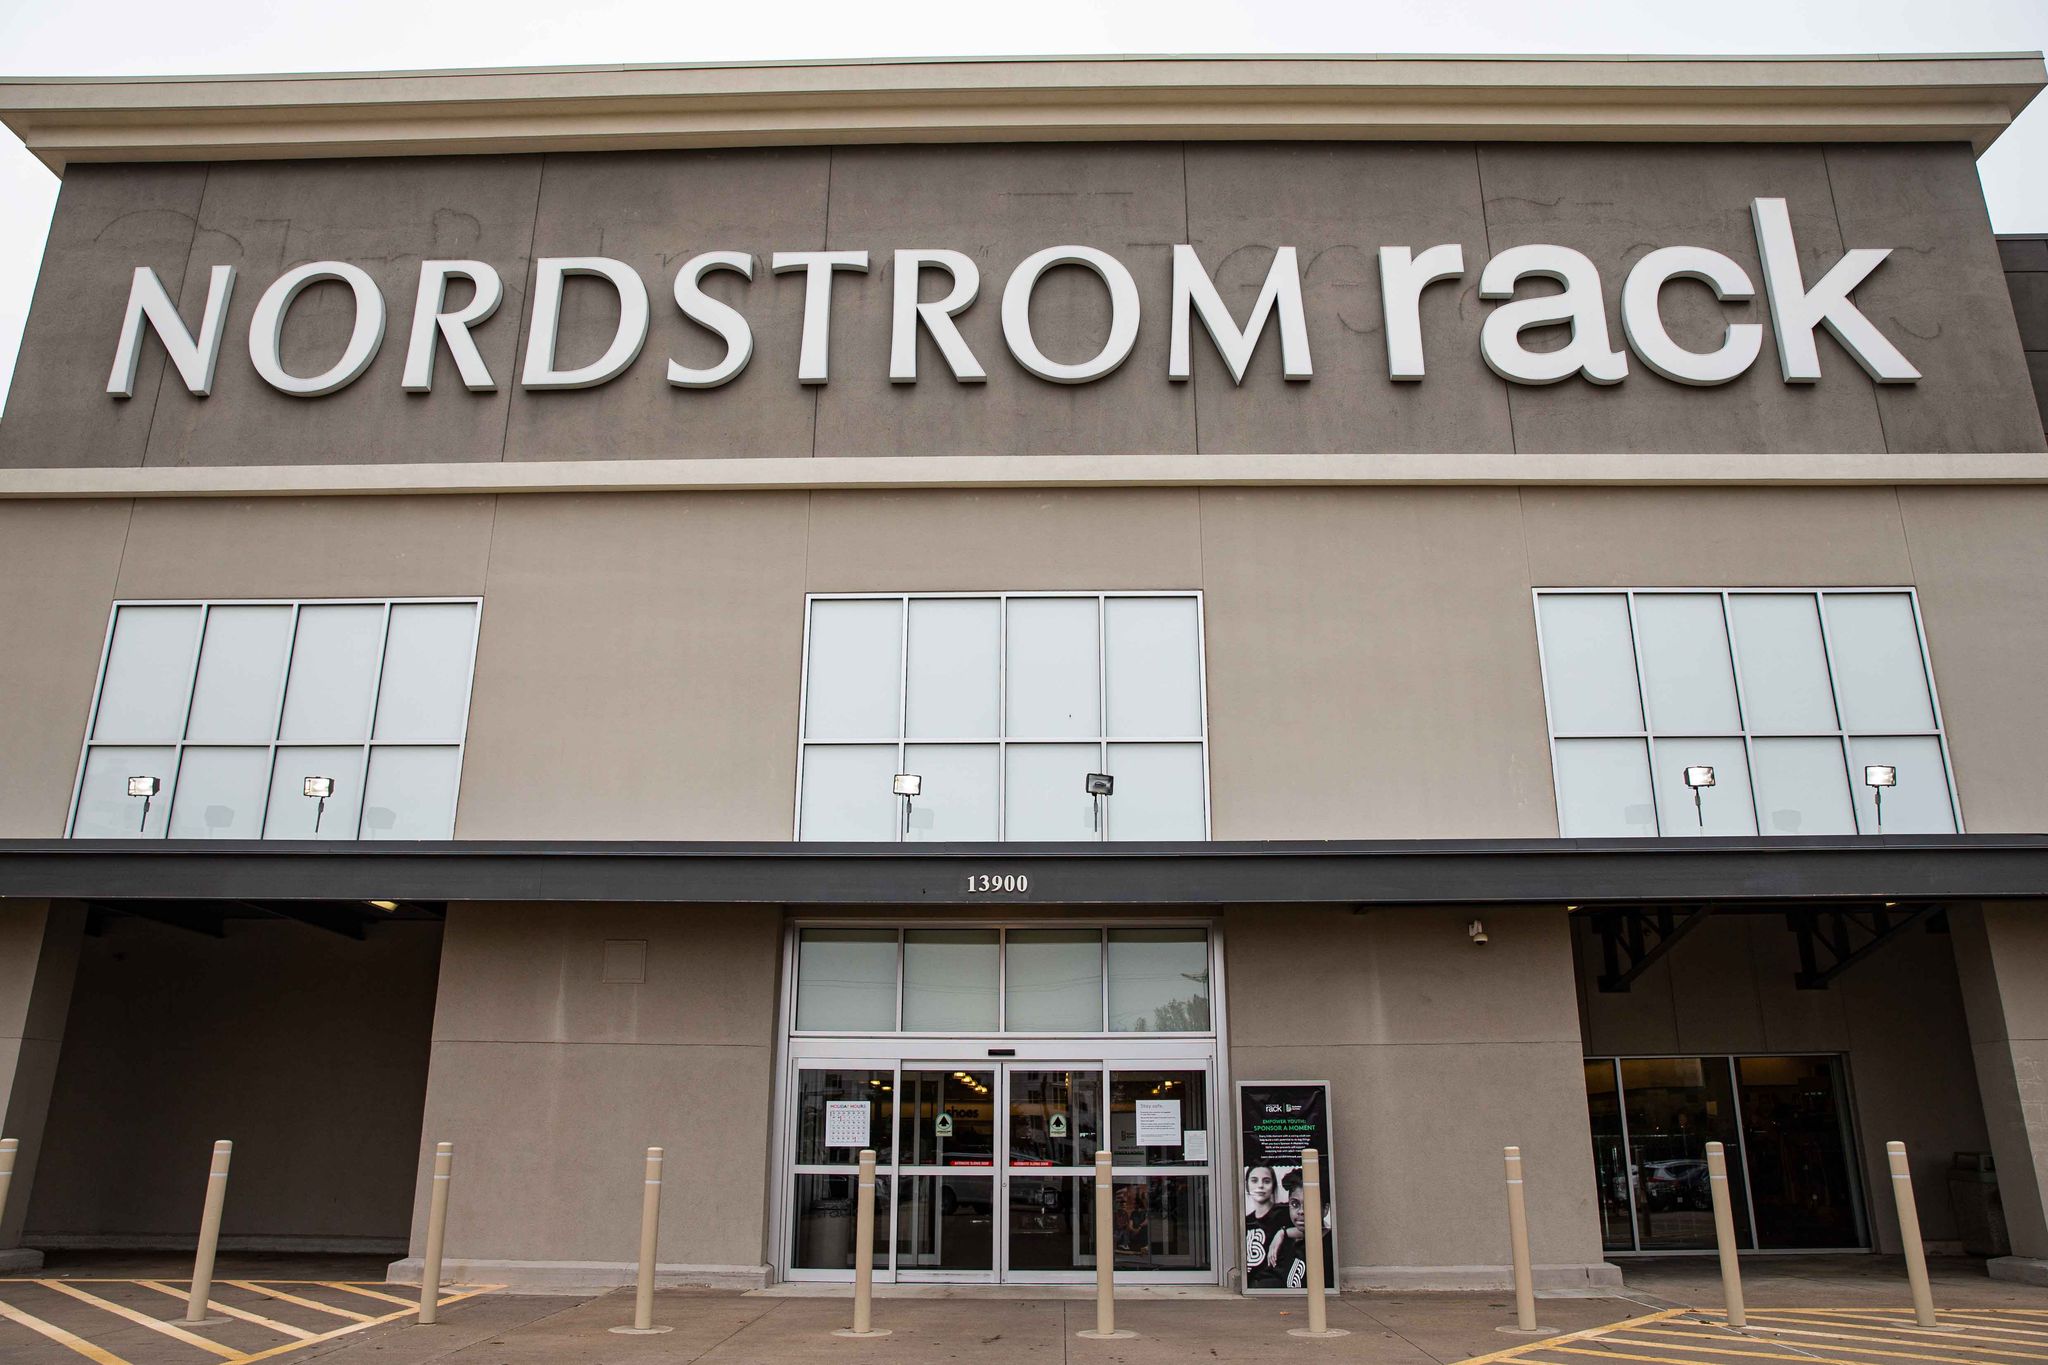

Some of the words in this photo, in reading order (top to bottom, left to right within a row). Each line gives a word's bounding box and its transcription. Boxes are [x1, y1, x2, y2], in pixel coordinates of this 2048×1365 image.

[106, 244, 1313, 397] NORDSTROM
[1377, 197, 1922, 386] rack
[967, 874, 1029, 892] 13900
[946, 1105, 979, 1118] shoes
[1266, 1104, 1282, 1112] rack
